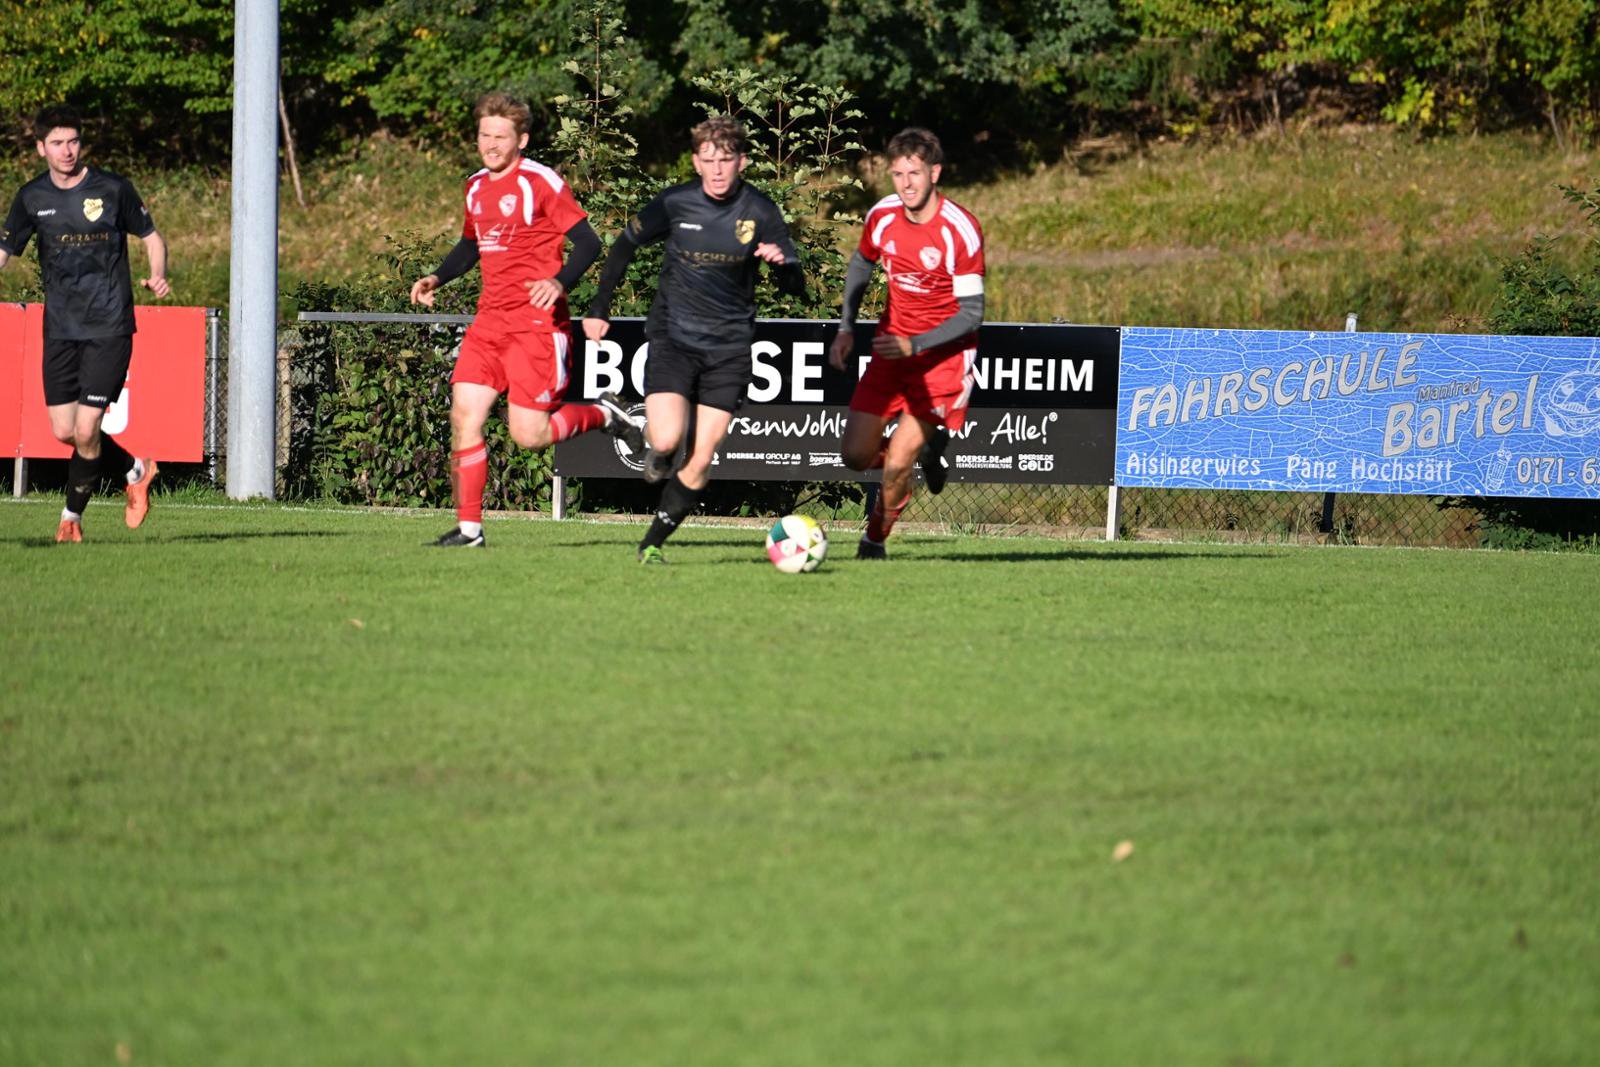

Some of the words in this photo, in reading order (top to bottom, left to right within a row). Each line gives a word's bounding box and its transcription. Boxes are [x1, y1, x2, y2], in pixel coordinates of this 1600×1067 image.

[583, 339, 825, 402] BSE
[858, 355, 1095, 392] NHEIM
[1128, 340, 1425, 433] FAHRSCHULE
[1417, 376, 1481, 403] Manfred
[1382, 372, 1540, 457] Bartel
[765, 453, 790, 461] GROUP
[790, 453, 802, 461] AG
[955, 454, 999, 463] BOERSE.DE
[1018, 460, 1054, 472] GOLD
[1126, 452, 1262, 477] Aisingerwies
[1351, 456, 1452, 482] Hochstätt
